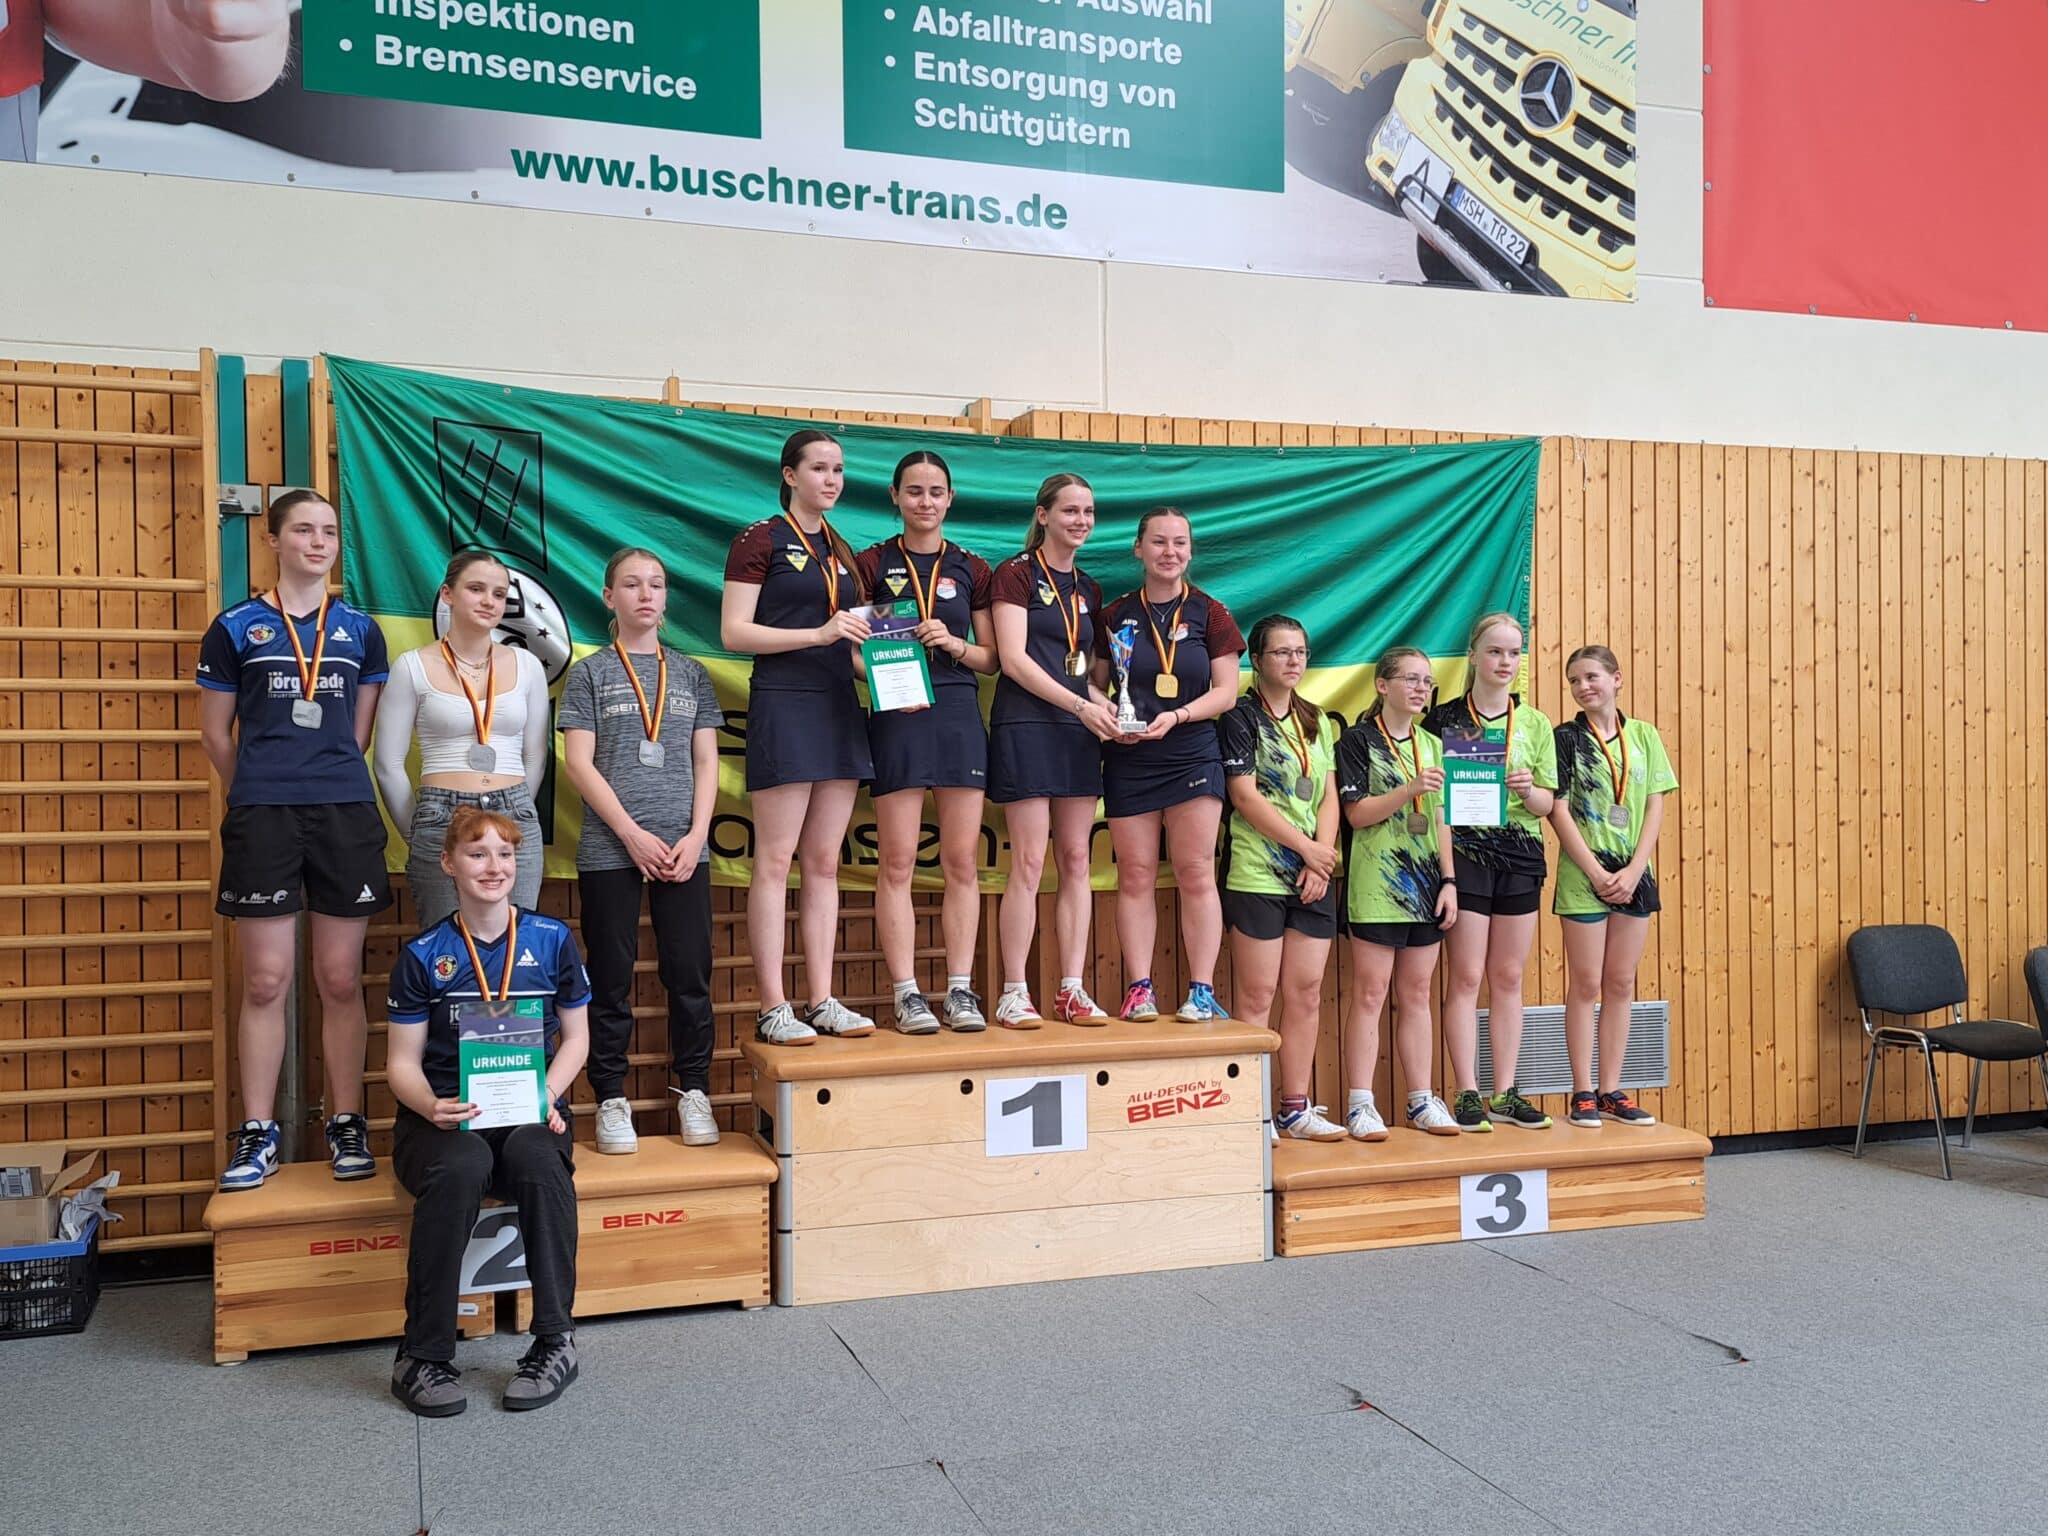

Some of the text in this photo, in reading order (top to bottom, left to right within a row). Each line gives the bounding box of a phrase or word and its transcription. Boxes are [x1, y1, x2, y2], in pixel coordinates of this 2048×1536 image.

[913, 5, 1183, 65] Abfalltransporte
[375, 34, 697, 100] Bremsenservice
[914, 51, 1176, 109] Entsorgung von
[914, 98, 1131, 149] Schüttgütern
[510, 147, 1069, 230] www.buschner-trans.de
[1459, 191, 1526, 260] MSH TR 22
[872, 648, 915, 661] URKUNDE
[1453, 769, 1497, 780] URKUNDE
[472, 1053, 532, 1069] URKUNDE
[1001, 1080, 1063, 1148] 1
[1127, 1079, 1223, 1104] ALU-DESIGN by
[1127, 1089, 1223, 1124] BENZ
[602, 1209, 684, 1229] BENZ
[1476, 1173, 1527, 1234] 3
[309, 1235, 401, 1256] BENZ
[471, 1212, 529, 1287] 2
